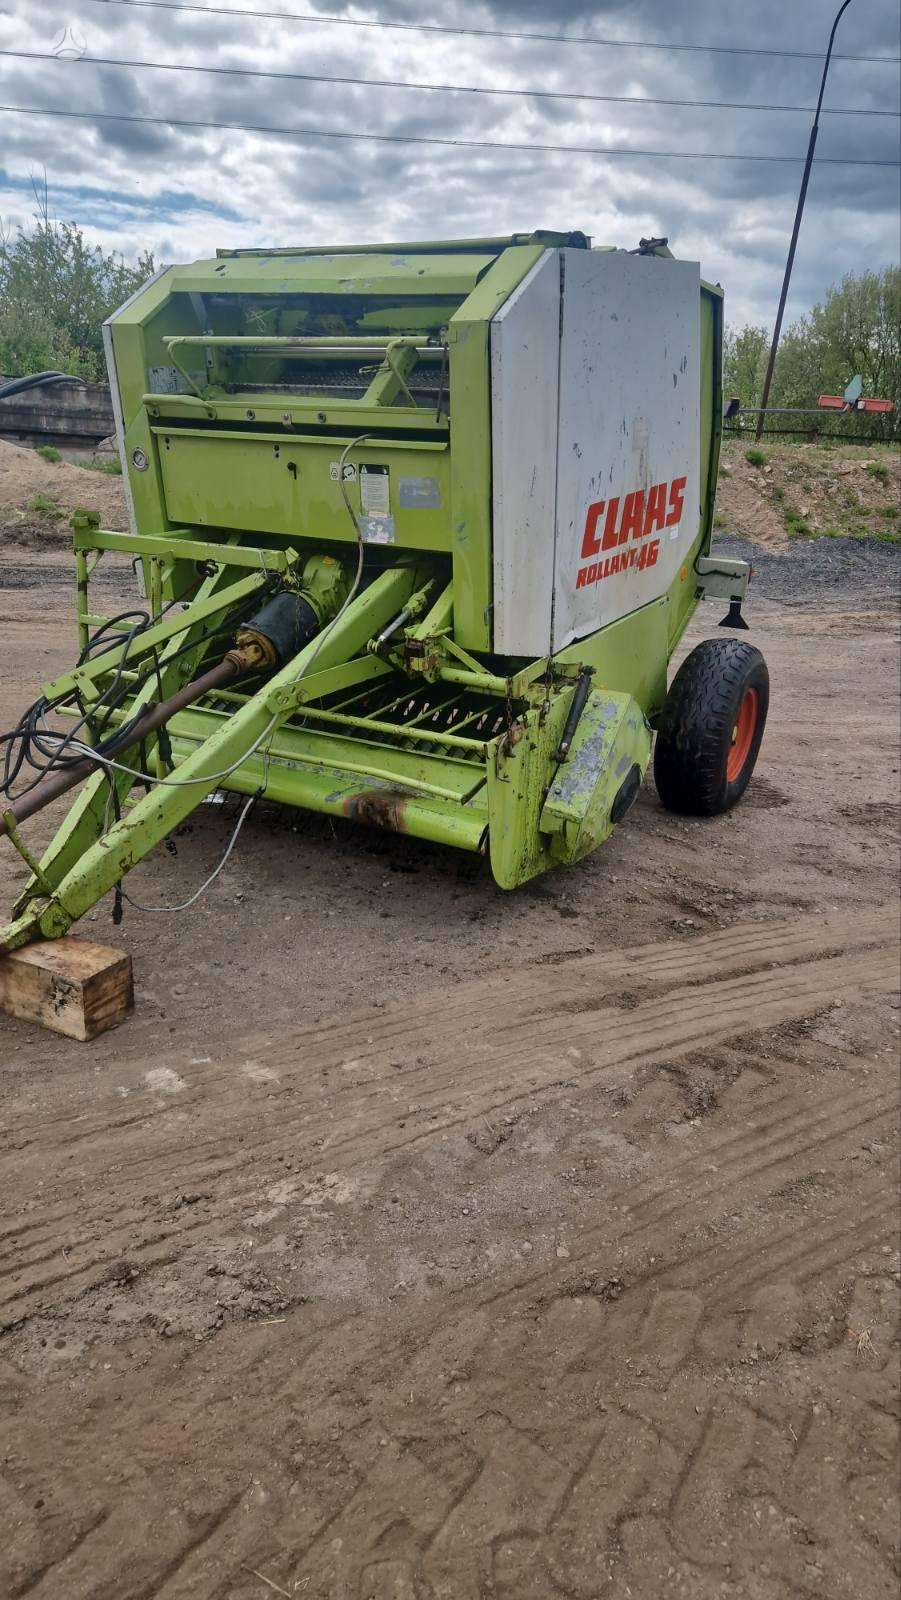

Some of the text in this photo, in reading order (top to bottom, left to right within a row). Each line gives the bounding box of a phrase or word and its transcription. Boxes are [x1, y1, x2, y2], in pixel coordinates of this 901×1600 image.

[581, 476, 687, 558] CLAAS
[576, 538, 660, 589] ROLLANT 46
